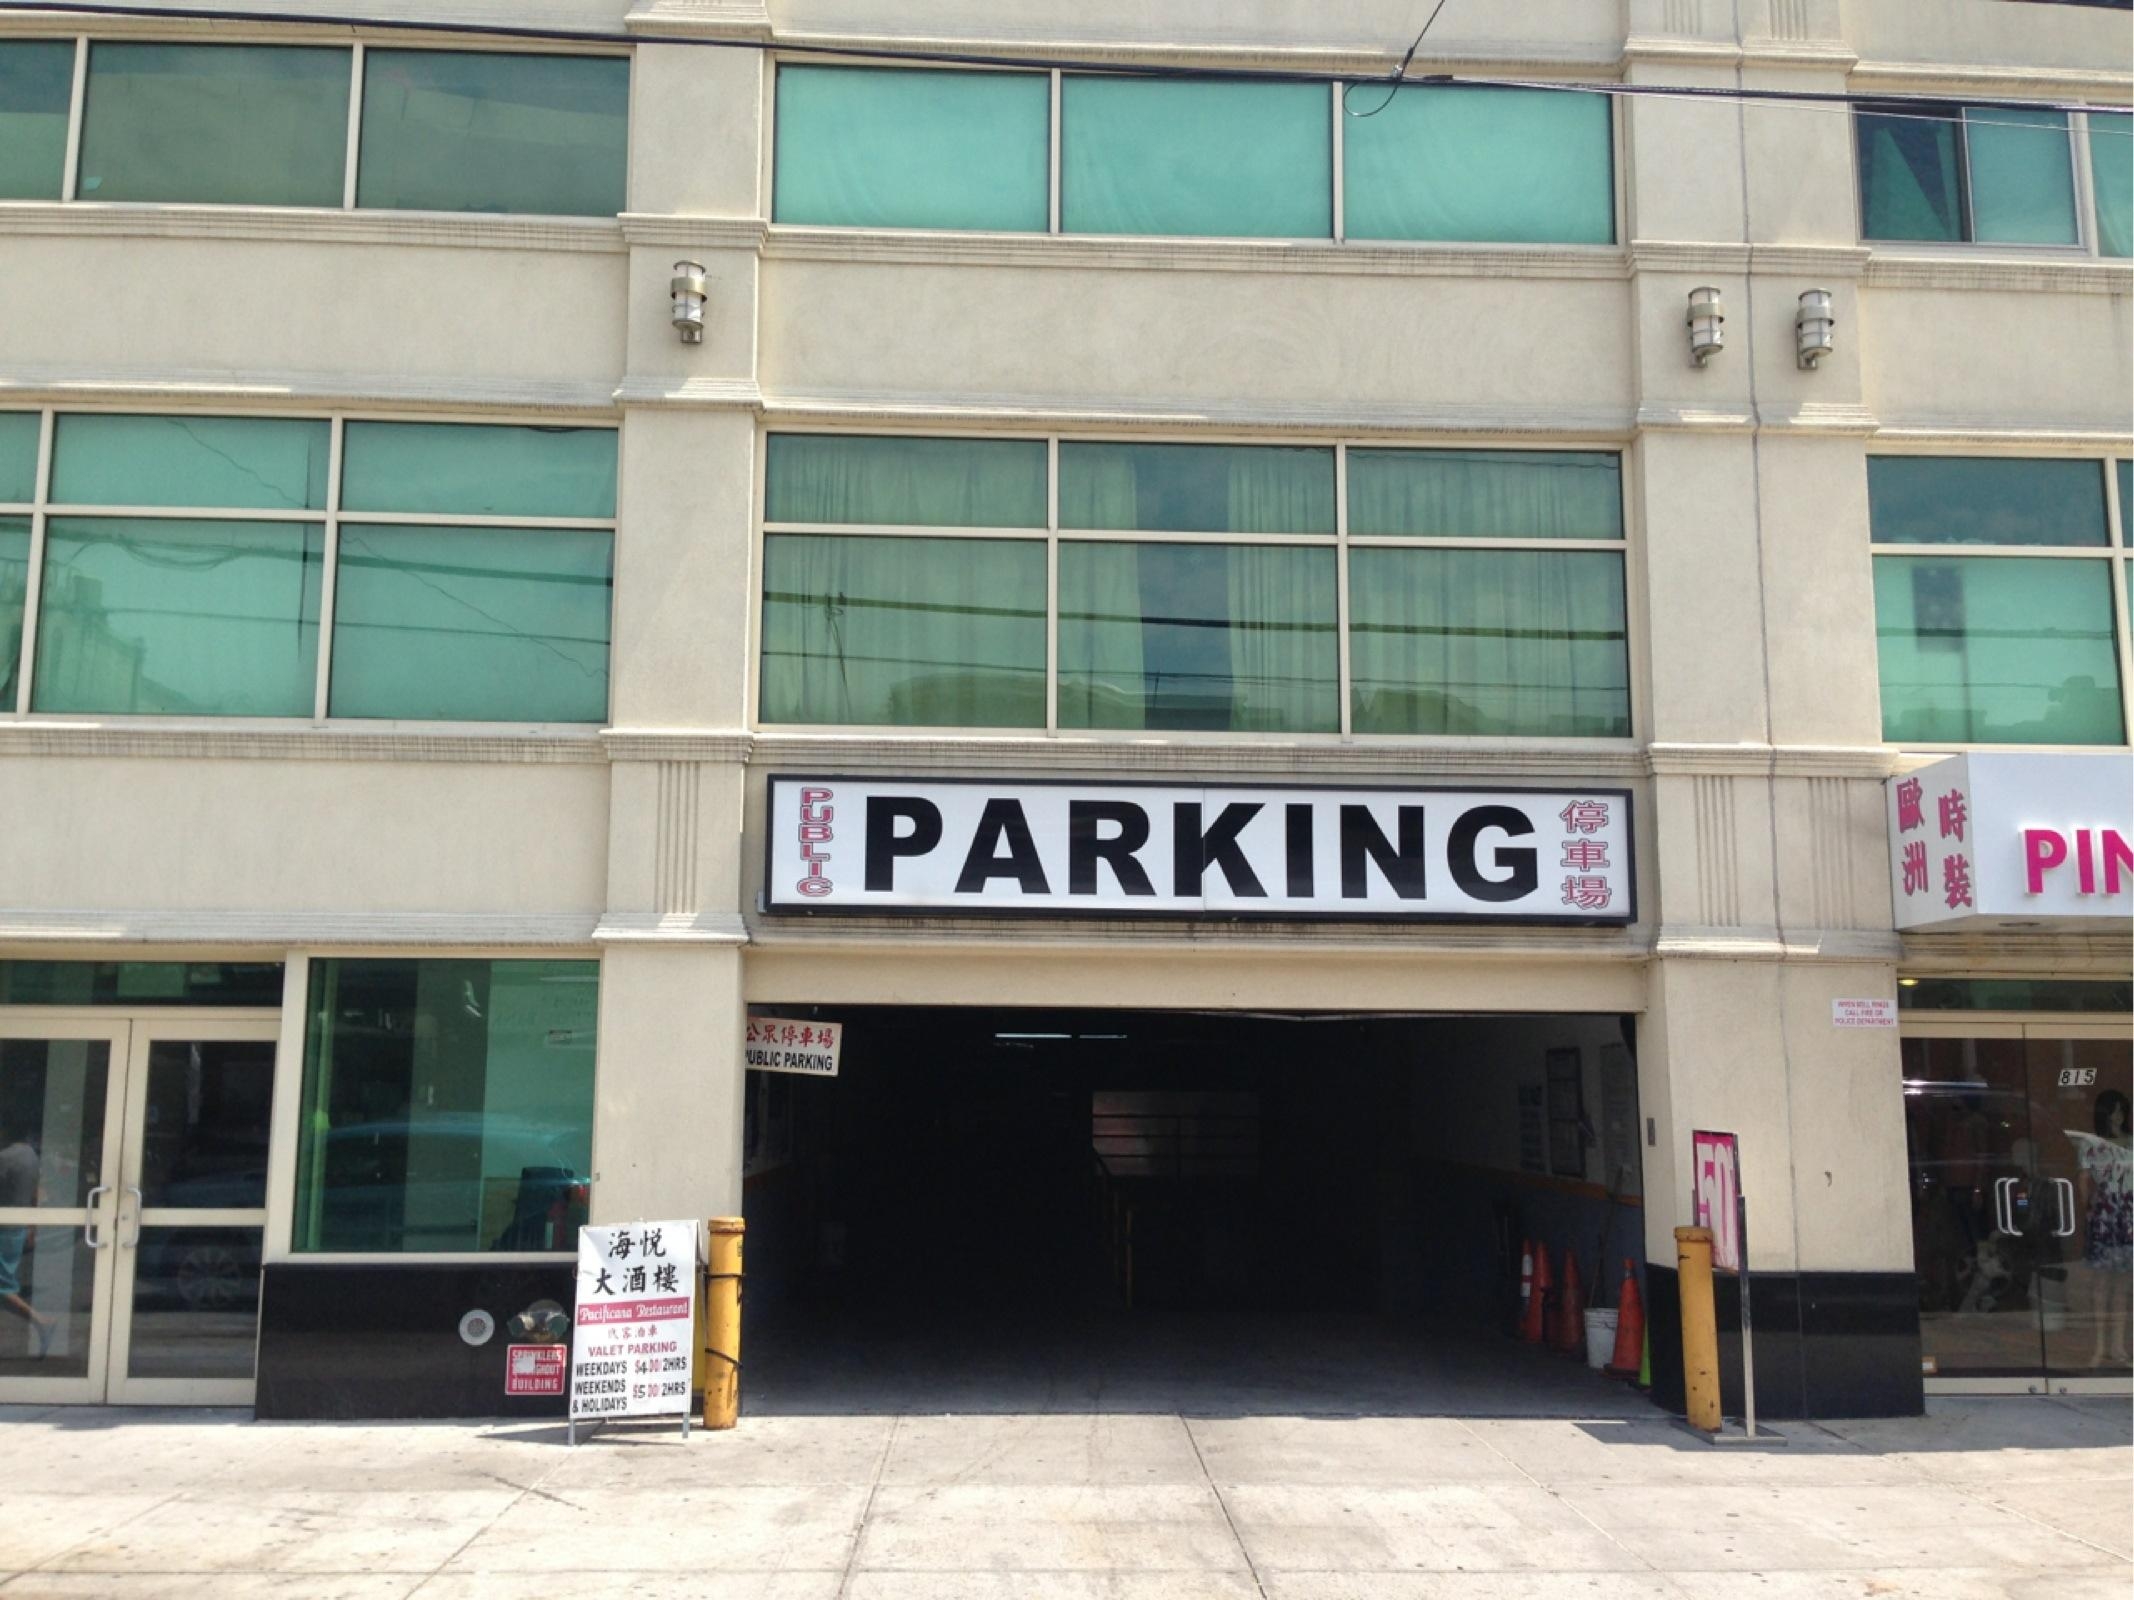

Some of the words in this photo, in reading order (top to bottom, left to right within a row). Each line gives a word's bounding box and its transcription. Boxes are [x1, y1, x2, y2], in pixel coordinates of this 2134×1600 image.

[796, 787, 834, 897] PUBLIC
[1896, 777, 1929, 896] 歐洲
[864, 796, 1539, 902] PARKING
[1559, 799, 1612, 910] 停車場
[1938, 788, 1973, 909] 時裝
[784, 1052, 833, 1071] PARKING
[2061, 1069, 2094, 1085] 815
[594, 1263, 679, 1296] 大酒樓
[636, 1301, 688, 1318] Restaurant
[588, 1344, 624, 1357] VALET
[627, 1341, 678, 1355] PARKING
[576, 1360, 628, 1377] WEEKDAYS
[512, 1378, 559, 1391] BUILDING
[574, 1378, 626, 1395] WEEKENDS
[582, 1396, 628, 1413] HOLIDAYS
